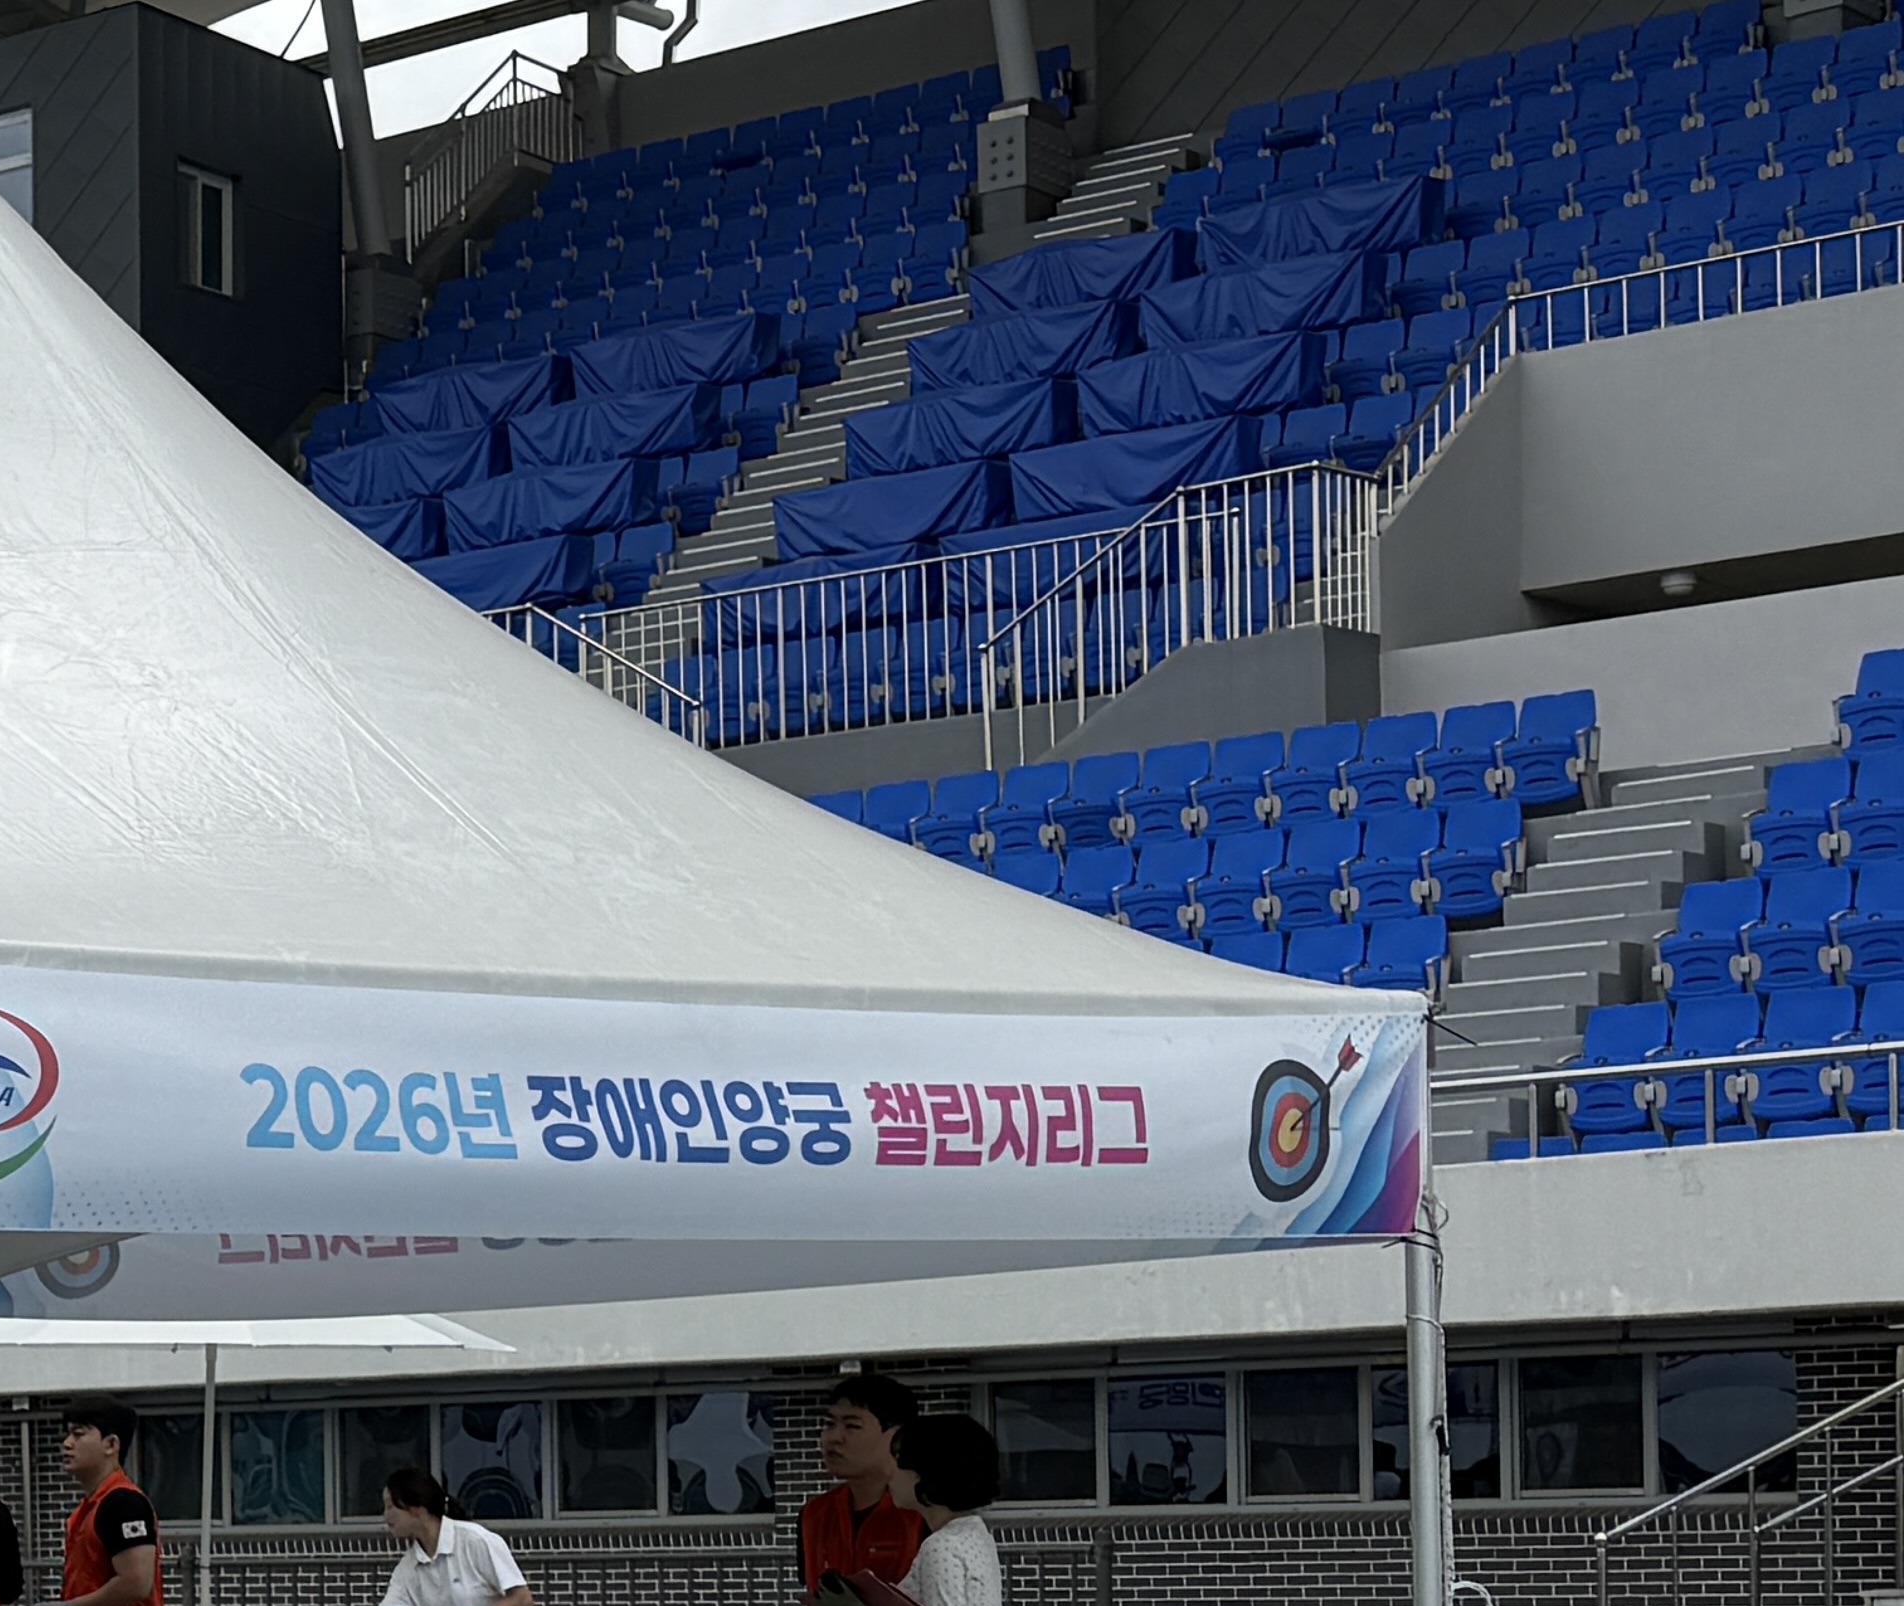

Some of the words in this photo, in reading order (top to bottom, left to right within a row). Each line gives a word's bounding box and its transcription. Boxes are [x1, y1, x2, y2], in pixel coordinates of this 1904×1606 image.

[239, 1063, 520, 1161] 2026년
[526, 1074, 852, 1166] 장애인양궁
[865, 1081, 1150, 1168] 챌린지리그
